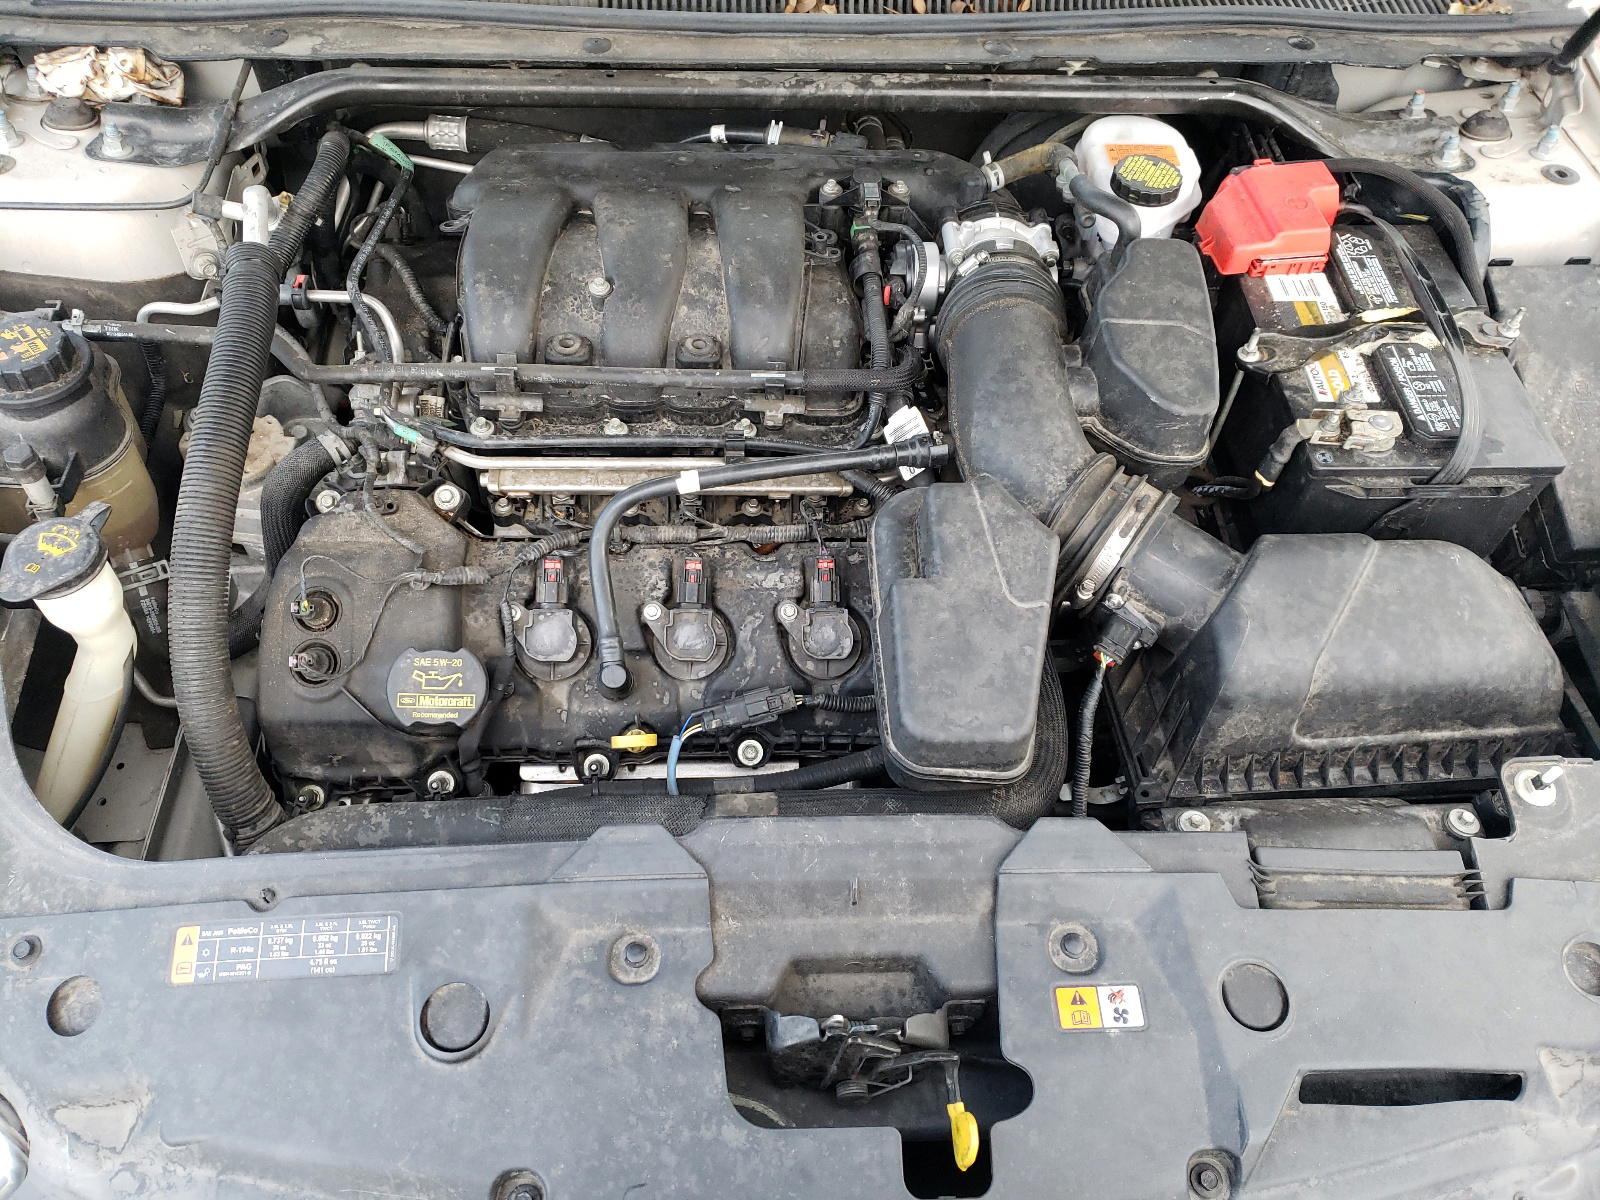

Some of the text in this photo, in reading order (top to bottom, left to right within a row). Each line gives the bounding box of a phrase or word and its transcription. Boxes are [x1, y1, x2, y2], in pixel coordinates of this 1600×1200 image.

[1388, 357, 1406, 382] POISON
[1402, 386, 1422, 415] DANGER
[414, 658, 463, 667] SAE 5W-20
[418, 696, 473, 707] Motorcraft
